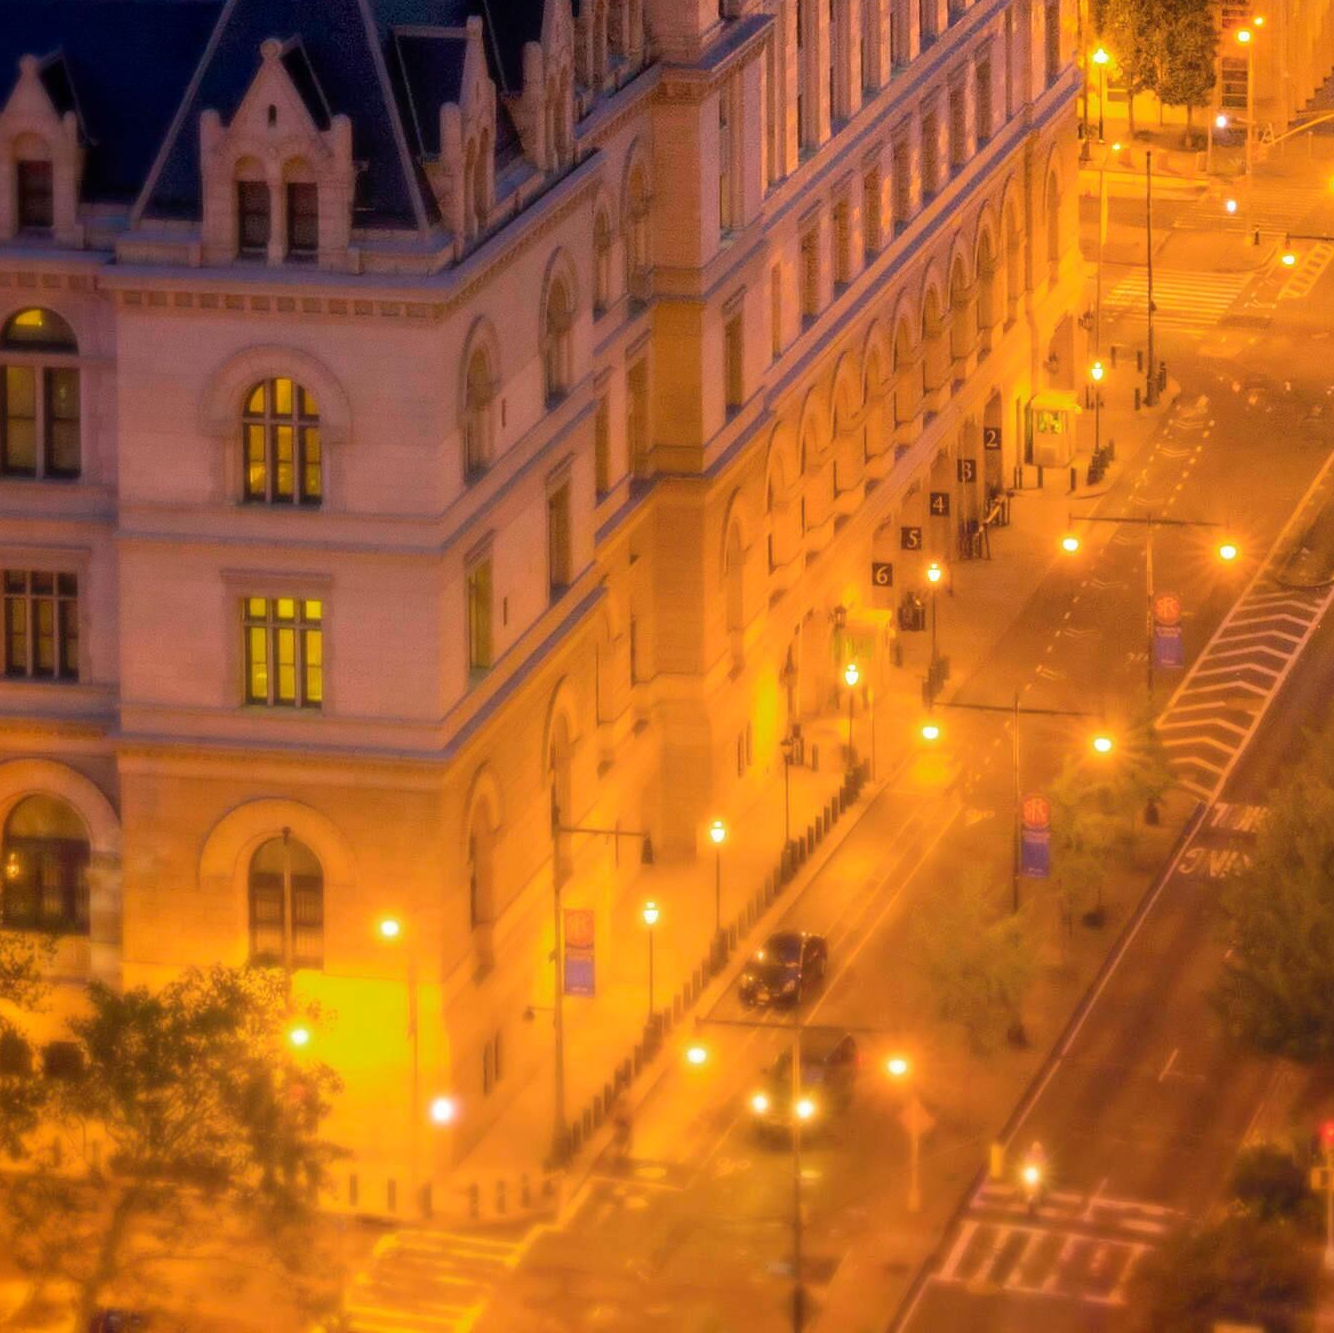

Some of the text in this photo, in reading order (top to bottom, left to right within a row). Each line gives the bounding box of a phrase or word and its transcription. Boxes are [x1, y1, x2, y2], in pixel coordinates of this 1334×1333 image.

[986, 429, 998, 447] 2
[932, 495, 944, 514] 4
[907, 529, 919, 549] 5
[876, 566, 888, 585] 6
